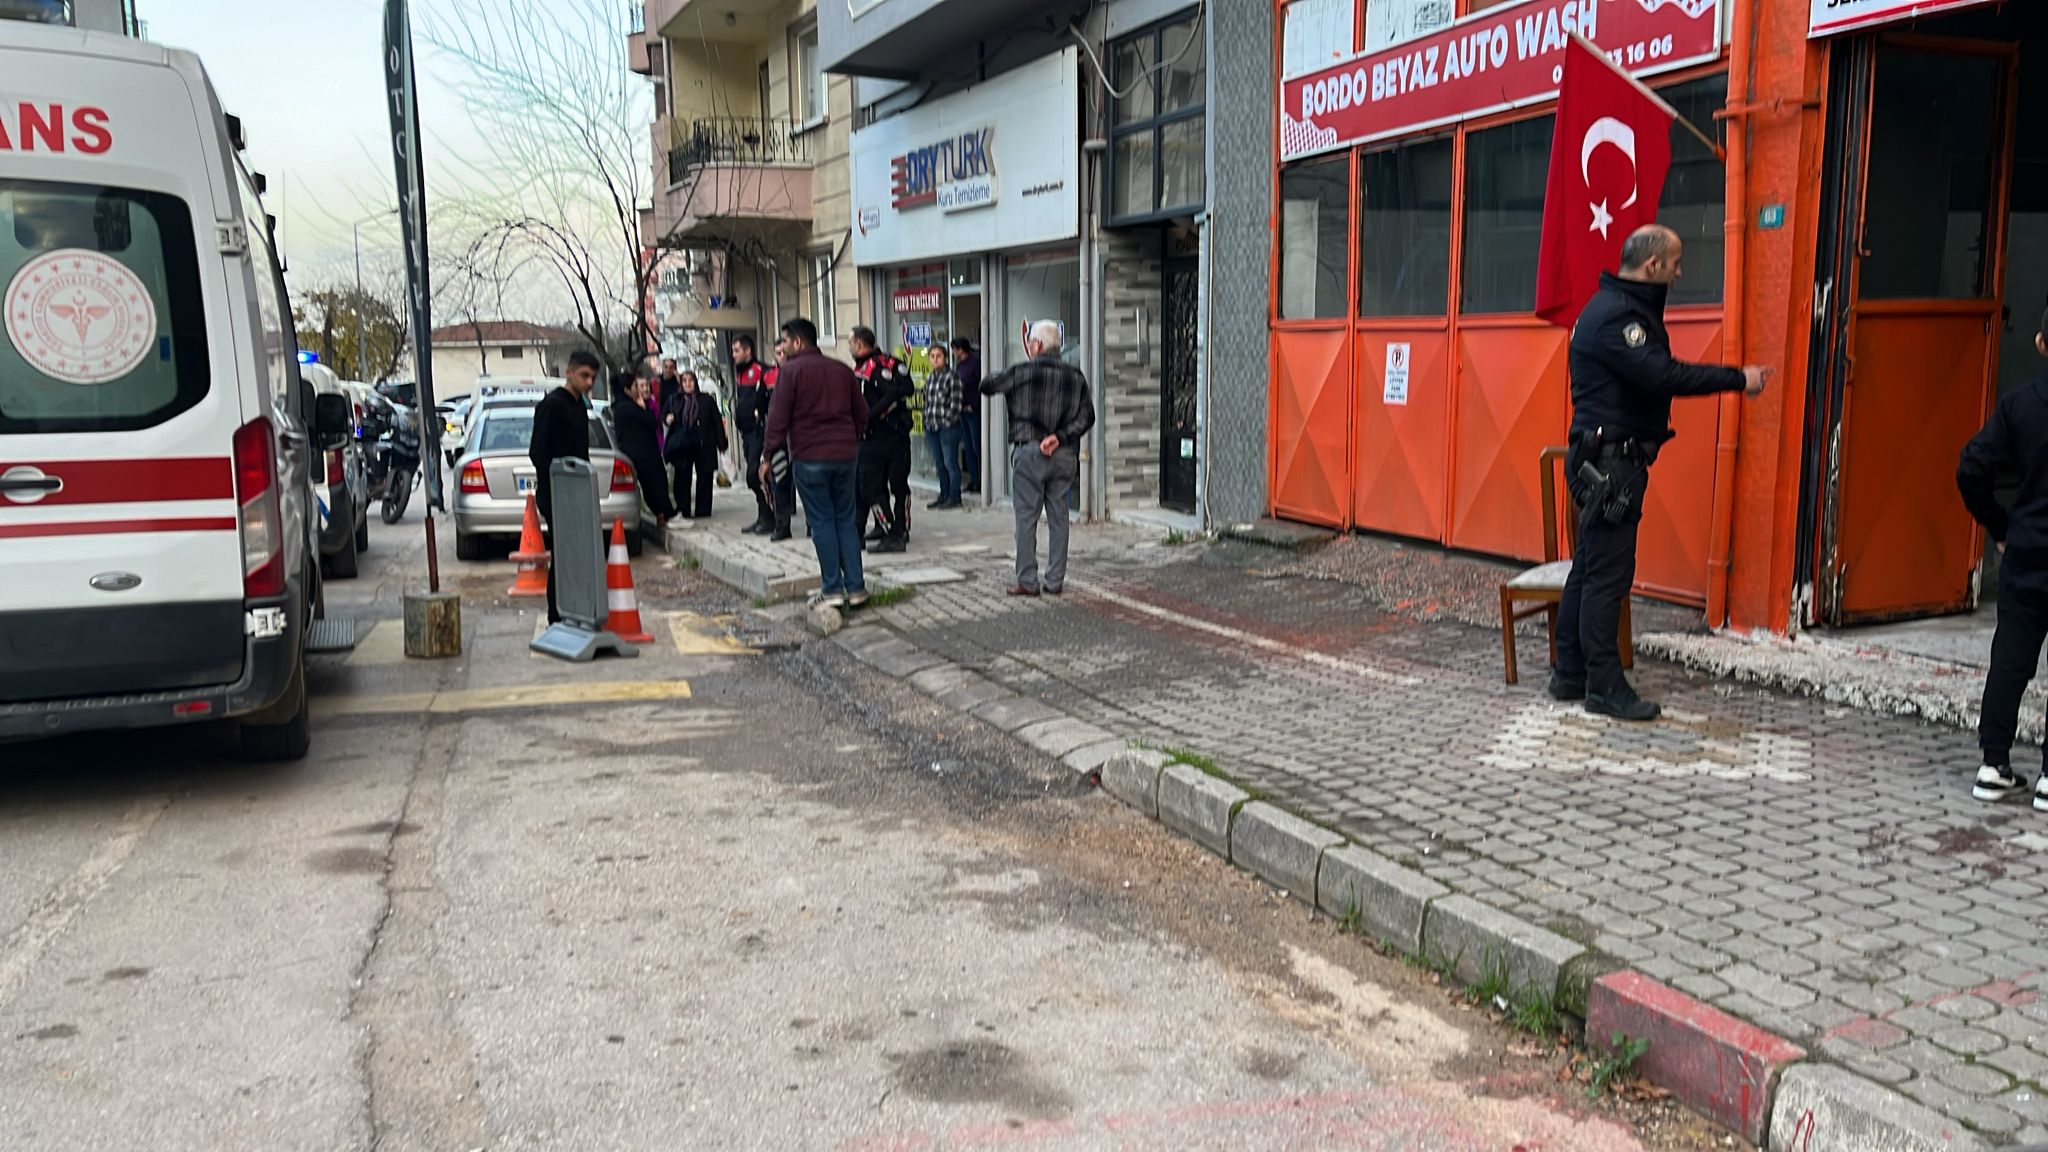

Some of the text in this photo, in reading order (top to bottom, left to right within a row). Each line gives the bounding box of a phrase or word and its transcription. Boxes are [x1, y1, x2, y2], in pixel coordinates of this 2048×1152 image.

[1302, 0, 1598, 119] BORDO BEYAZ AUTO WASH
[1626, 41, 1645, 65] 16
[1649, 34, 1673, 59] 06
[937, 183, 990, 208] Kuru Temizleme
[894, 295, 909, 312] KURU
